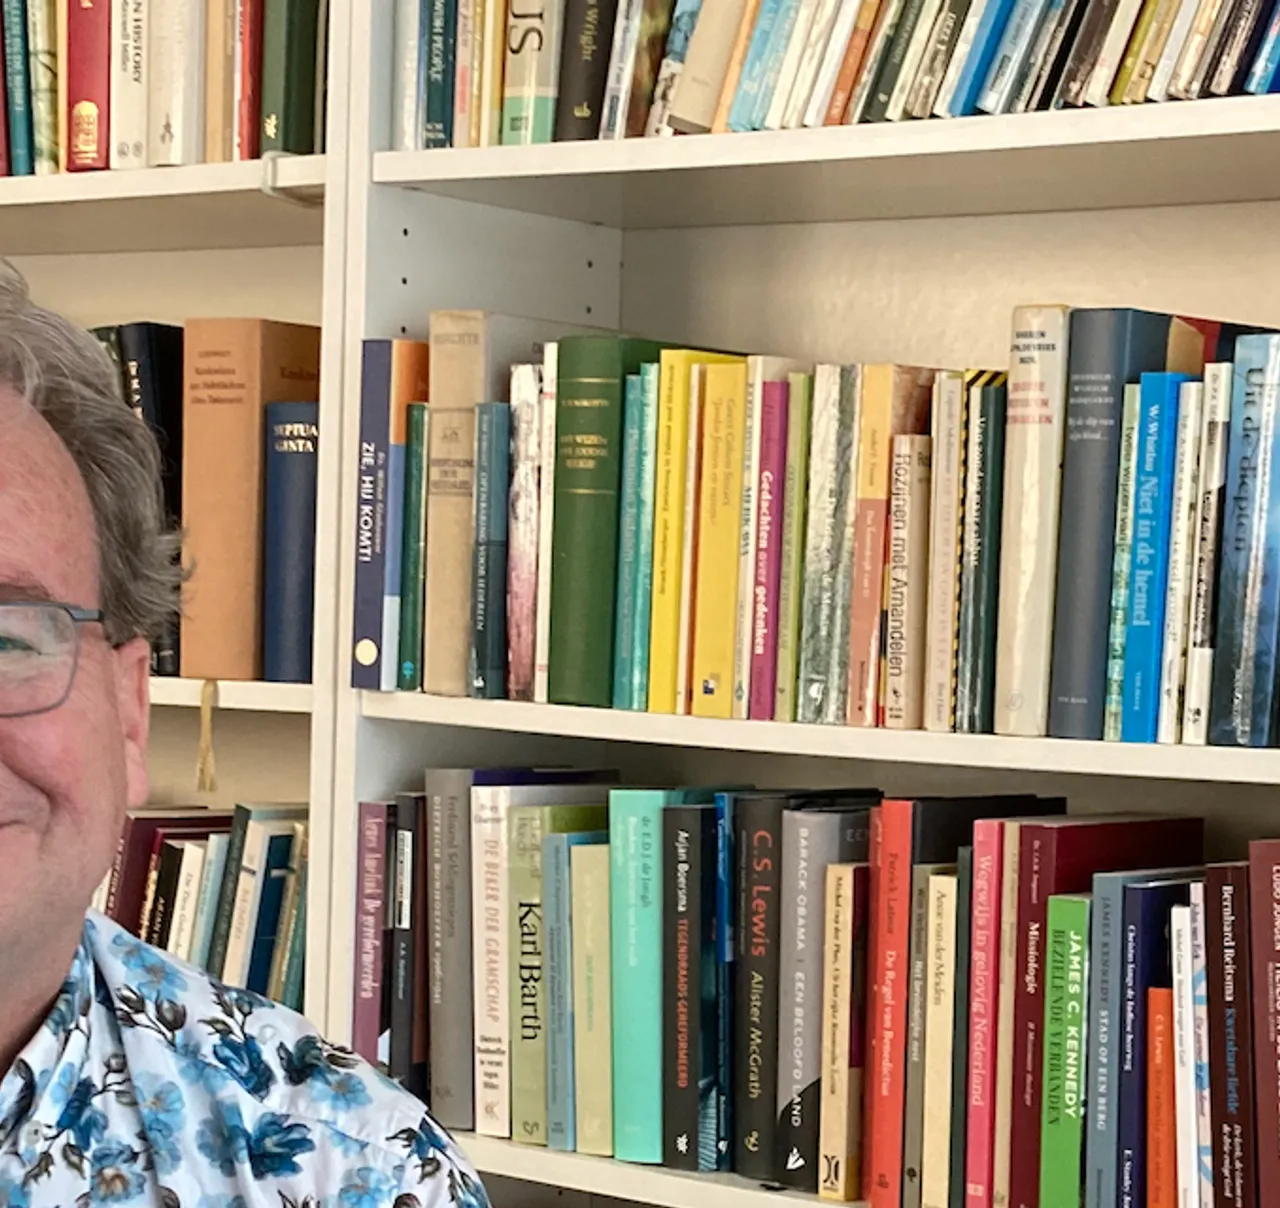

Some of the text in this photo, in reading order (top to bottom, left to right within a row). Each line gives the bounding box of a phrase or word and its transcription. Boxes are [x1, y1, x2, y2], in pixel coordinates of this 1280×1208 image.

[580, 9, 599, 61] Wright
[358, 442, 374, 561] ZIE, HIJ KOMT!
[753, 471, 773, 654] Gedachten over gedenken
[889, 453, 912, 676] Rozijnen met Amandelen
[1133, 475, 1160, 625] Niet in de hemel
[674, 830, 690, 912] Arjan Boersma
[750, 830, 773, 957] C.S. Lewis
[796, 827, 808, 950] BARACK OBAMA
[518, 901, 543, 1042] Karl Barth
[970, 855, 993, 1106] Wegwijs in gelovig Nederland
[1024, 921, 1040, 993] Missiologie
[1064, 930, 1082, 1118] JAMES C. KENNEDY
[748, 971, 764, 1098] Alister McGrath
[790, 971, 805, 1127] EEN BELOOFD LAND
